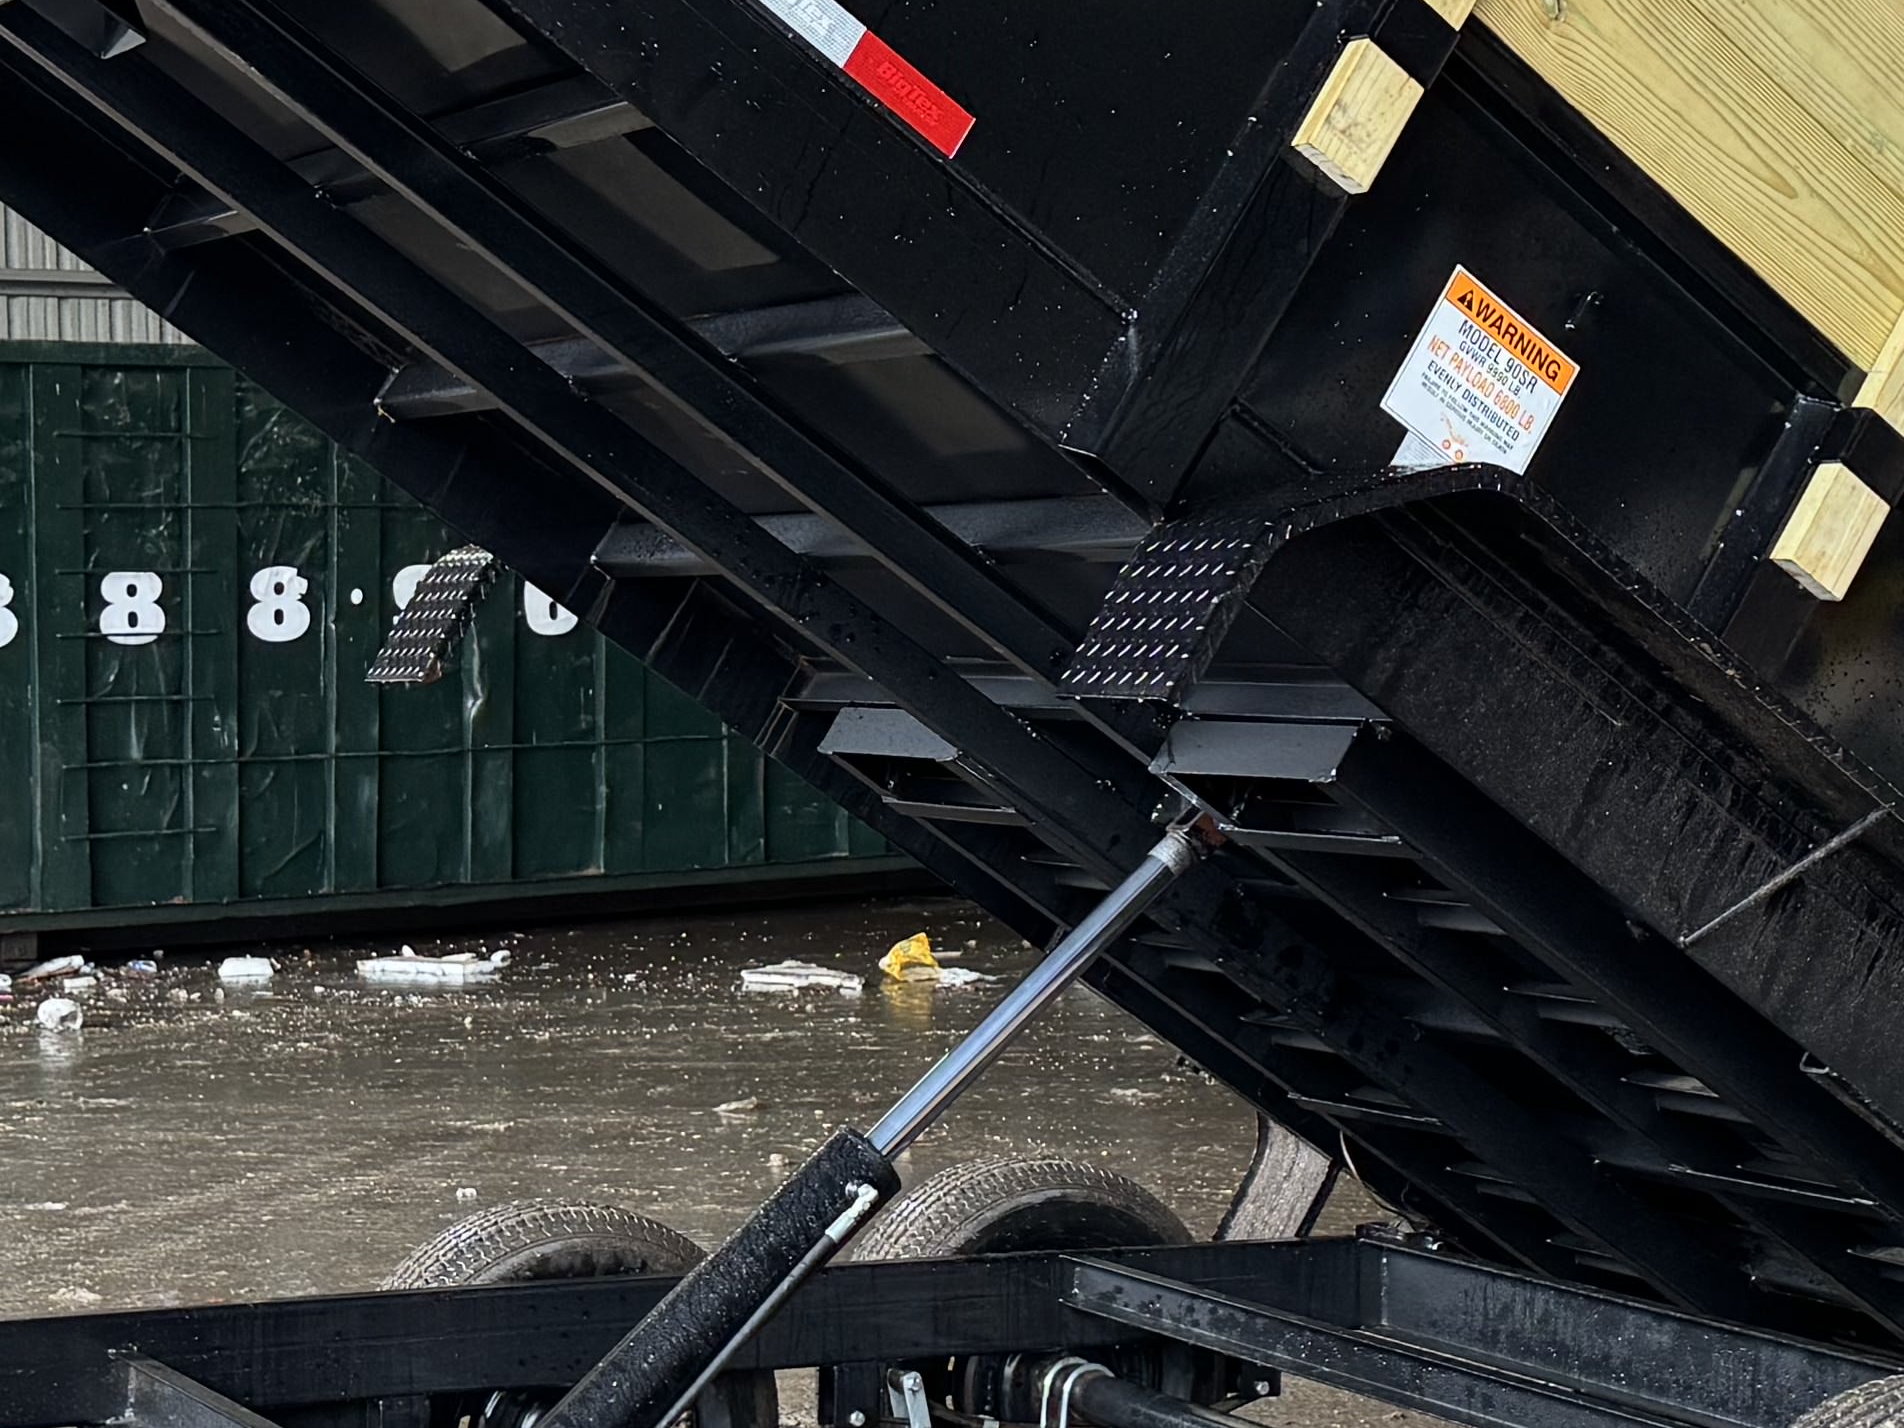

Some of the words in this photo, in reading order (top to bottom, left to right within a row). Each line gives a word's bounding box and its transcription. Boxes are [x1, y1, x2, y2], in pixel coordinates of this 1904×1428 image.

[877, 62, 943, 120] BigTex
[1458, 319, 1503, 365] MODEL
[1504, 358, 1539, 394] 90SR
[1459, 340, 1488, 369] GVWR
[1508, 382, 1522, 399] LB.
[1475, 297, 1562, 382] WARNING
[1426, 334, 1451, 361] NET
[1449, 352, 1495, 398] PAYLOAD
[1495, 389, 1521, 420] 6800
[1518, 409, 1536, 435] LB.
[1427, 360, 1463, 393] EVENLY
[1462, 388, 1521, 442] DISTRIBUTED
[99, 571, 166, 645] 8
[246, 565, 309, 643] 8
